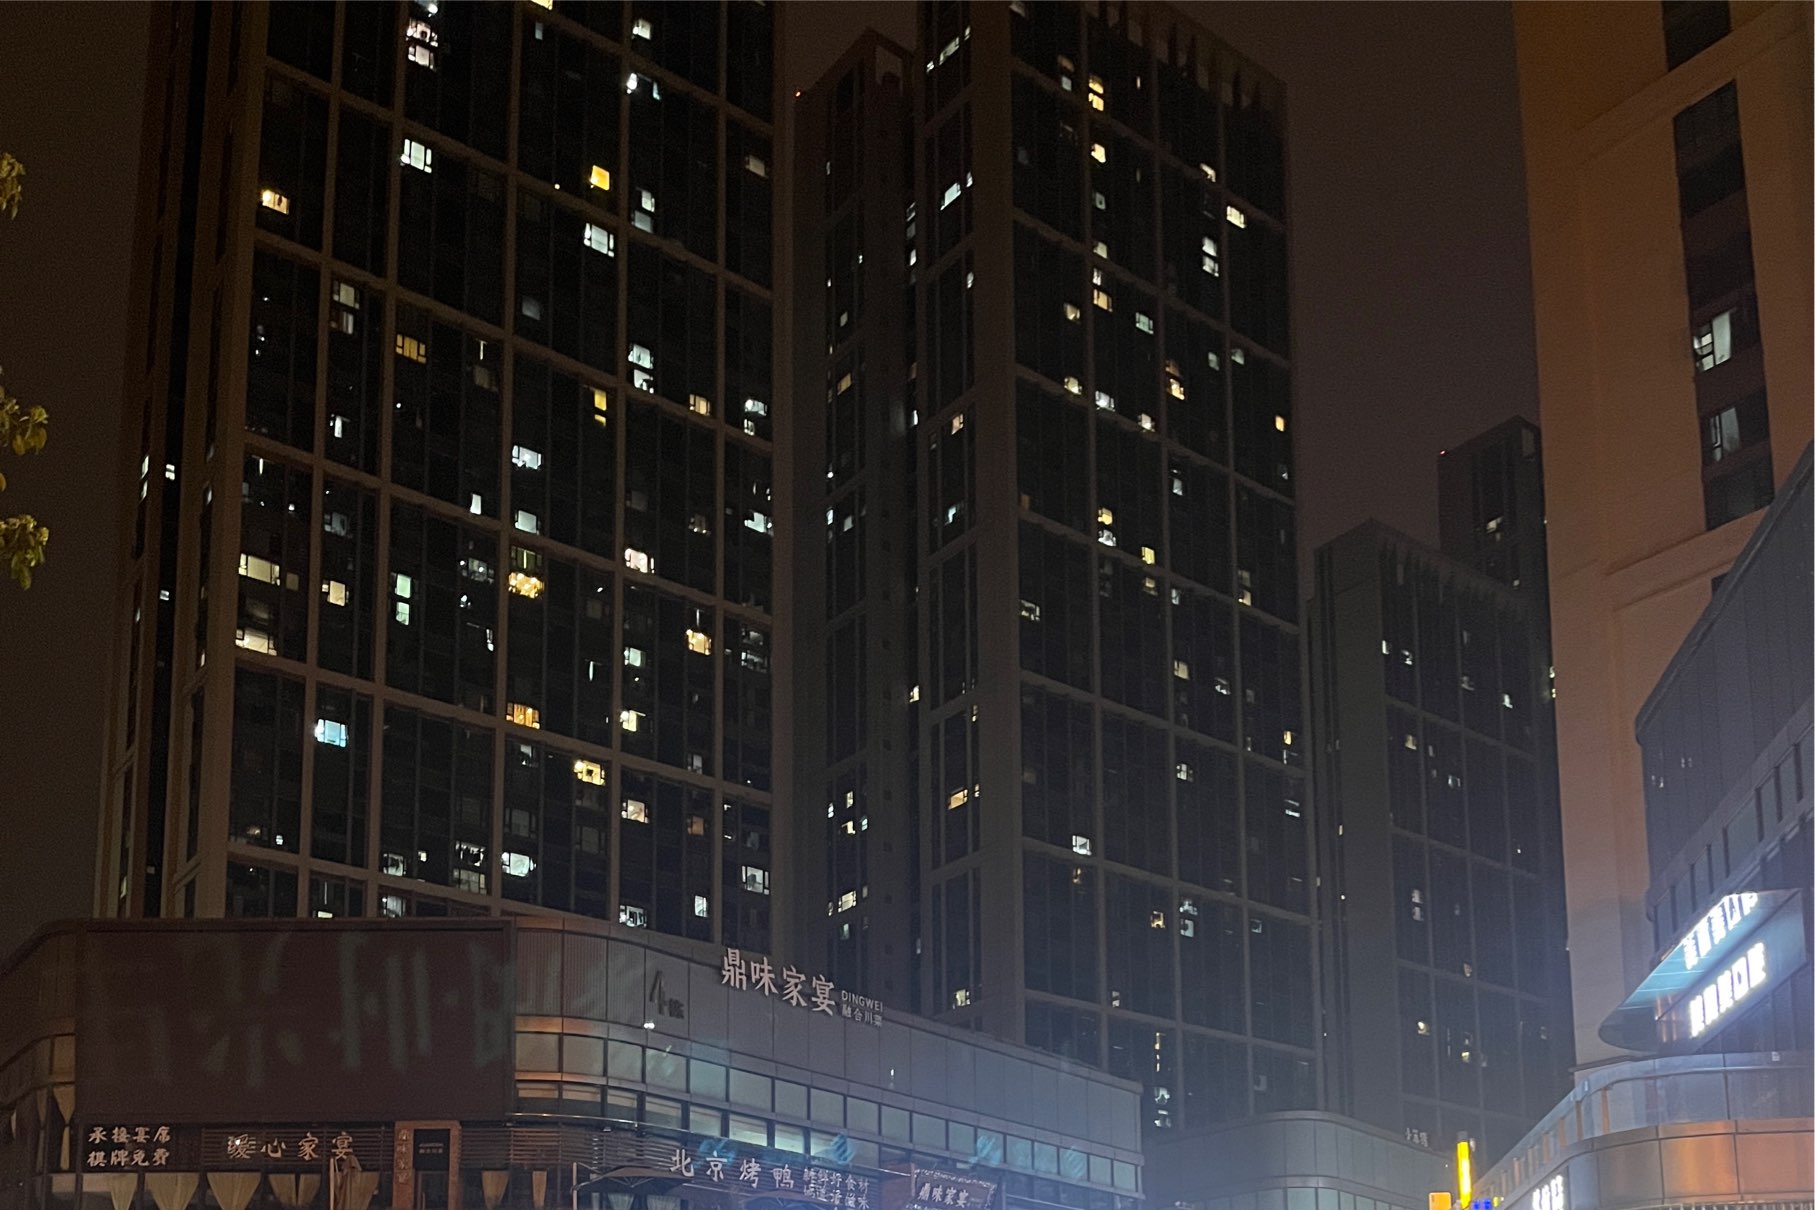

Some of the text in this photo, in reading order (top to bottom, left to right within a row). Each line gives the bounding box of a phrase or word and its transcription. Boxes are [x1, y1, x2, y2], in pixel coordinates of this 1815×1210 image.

[721, 948, 836, 1017] 鼎味家宴
[841, 990, 883, 1013] DINGWEI
[88, 1126, 171, 1144] 承接宴席
[227, 1131, 353, 1160] 暖心家宴
[87, 1148, 170, 1167] 棋牌免费
[670, 1149, 794, 1189] 北京烤鸭
[918, 1183, 969, 1209] 鼎味家宴
